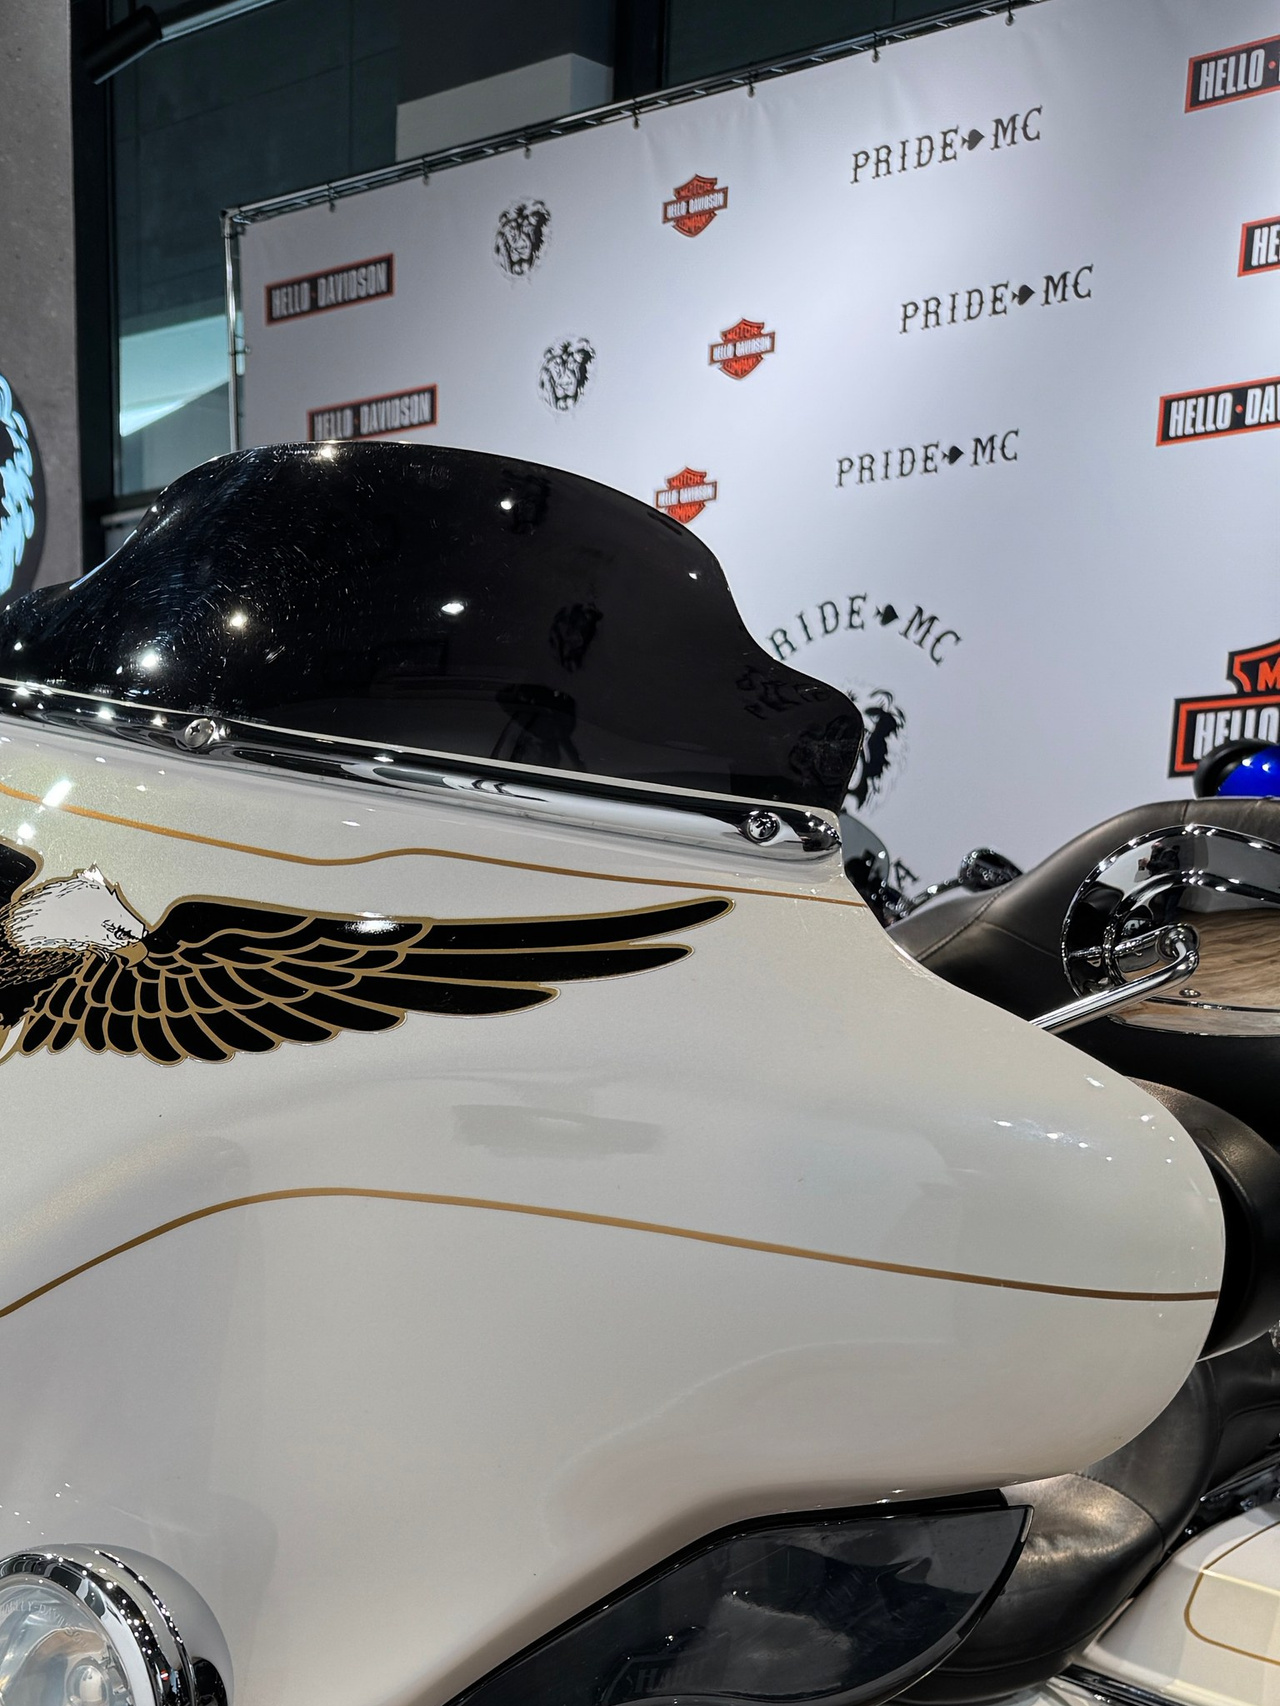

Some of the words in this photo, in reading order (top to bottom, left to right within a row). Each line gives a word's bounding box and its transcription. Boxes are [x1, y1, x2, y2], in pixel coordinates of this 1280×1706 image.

[1198, 48, 1265, 101] HELLO
[850, 125, 959, 184] PRIDE
[990, 104, 1043, 151] MC
[272, 282, 310, 319] HELLO
[317, 262, 388, 307] DAVIDSON
[899, 280, 1009, 334] PRIDE
[1040, 263, 1094, 307] MC
[314, 408, 354, 441] HELLO
[360, 391, 431, 435] DAVIDSON
[1169, 392, 1233, 438] HELLO
[1244, 383, 1280, 426] DA
[835, 440, 940, 488] PRIDE
[970, 427, 1019, 468] MC
[767, 594, 868, 661] RIDE
[899, 606, 963, 665] MC
